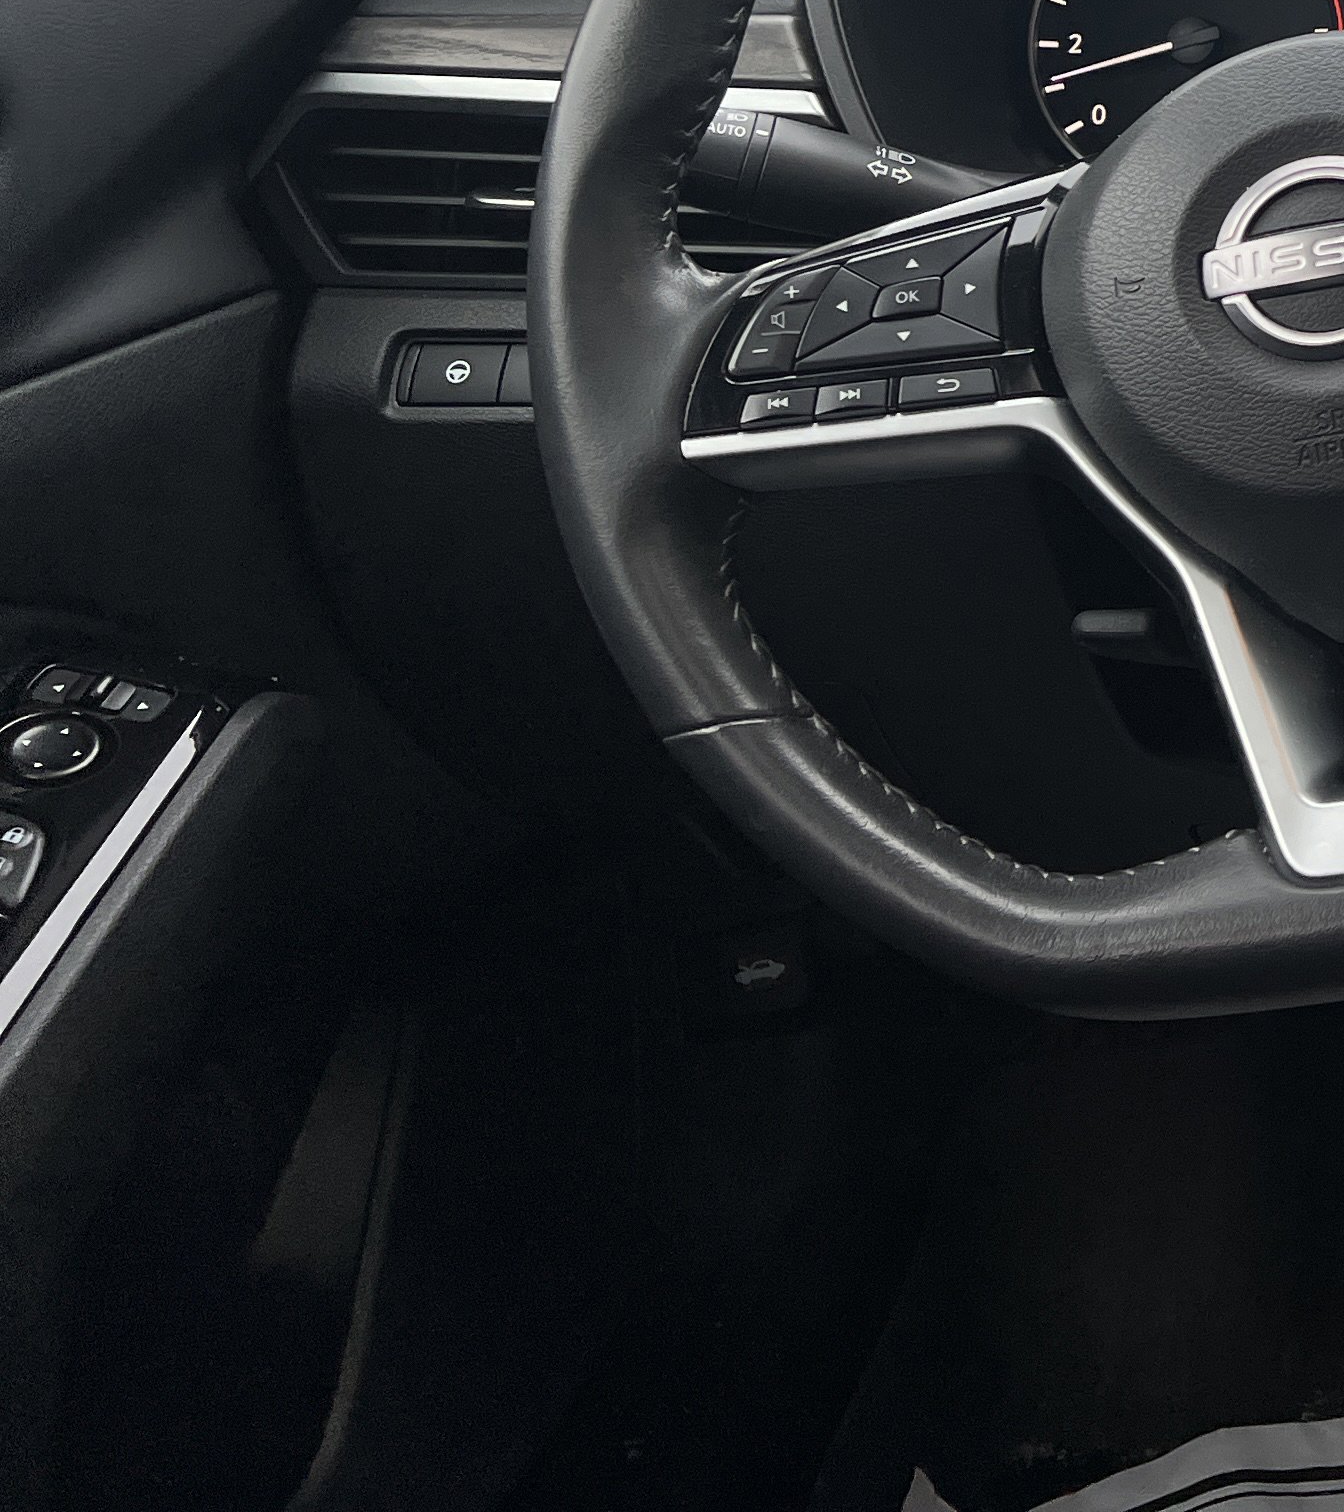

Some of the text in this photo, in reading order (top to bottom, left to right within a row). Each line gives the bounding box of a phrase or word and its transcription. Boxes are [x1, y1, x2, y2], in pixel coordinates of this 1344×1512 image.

[1068, 33, 1082, 54] 2
[1091, 103, 1107, 125] 0
[895, 289, 920, 305] OK
